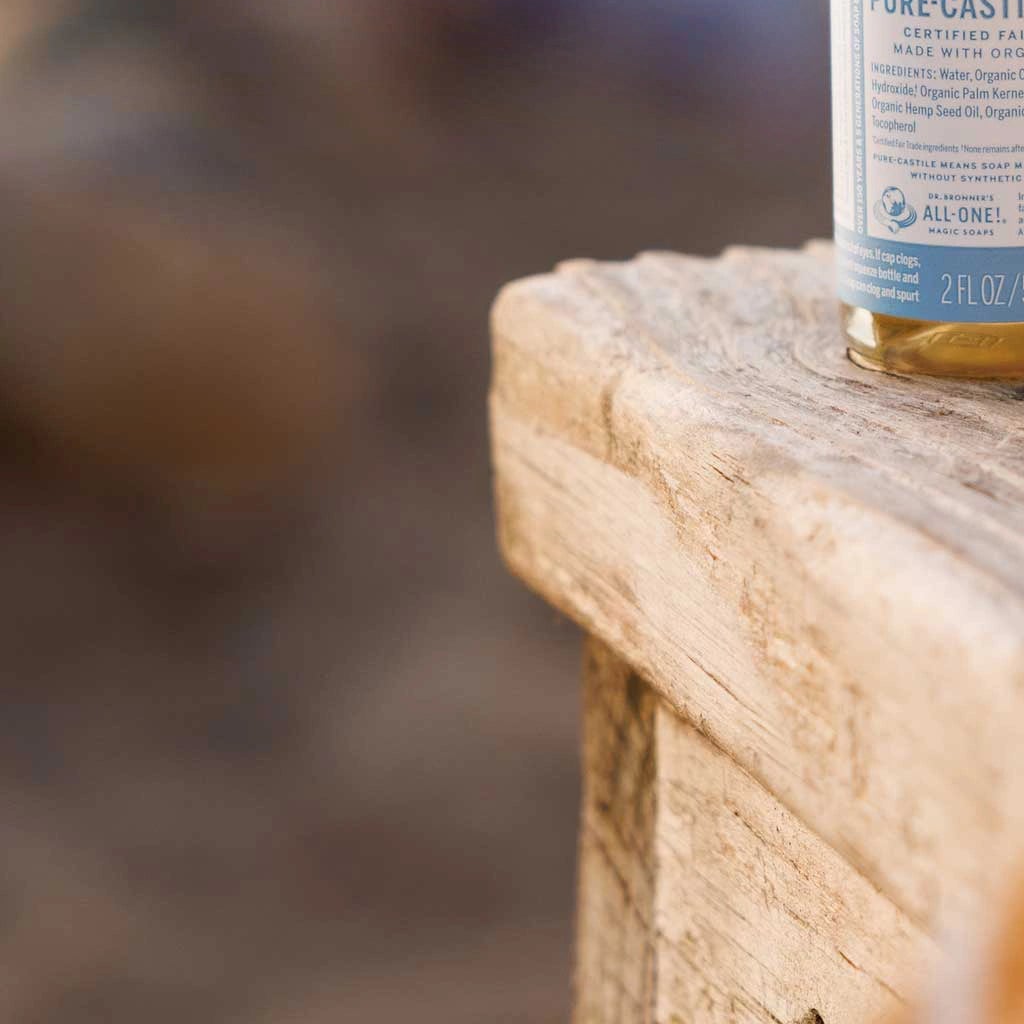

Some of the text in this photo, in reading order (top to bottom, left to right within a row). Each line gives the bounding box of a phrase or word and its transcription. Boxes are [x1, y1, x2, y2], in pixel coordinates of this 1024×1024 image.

[903, 27, 990, 41] CERTIFIED
[893, 43, 934, 57] MADE
[941, 47, 983, 59] WITH
[871, 62, 937, 80] INGREDIENTS:
[939, 69, 973, 82] Water,
[974, 68, 1016, 83] Organic
[920, 85, 960, 101] Organic
[962, 87, 989, 100] Palm
[871, 96, 903, 113] Organic
[905, 101, 934, 118] Hemp
[935, 105, 962, 118] Seed
[964, 105, 983, 119] Oil,
[871, 115, 916, 133] Tocopherol
[981, 143, 1012, 153] remains
[873, 153, 937, 168] PURE-CASTILE
[940, 161, 977, 170] MEANS
[981, 162, 1010, 170] SOAP
[910, 171, 956, 182] WITHOUT
[960, 174, 1022, 183] SYNTHETIC
[928, 192, 994, 202] DR. BRONNER'S
[923, 205, 1001, 224] ALL-ONE!
[928, 228, 994, 236] MAGIC SOAPS
[881, 251, 896, 266] cap
[896, 252, 921, 269] clogs,
[878, 266, 902, 282] bottle
[902, 271, 919, 284] and
[881, 286, 896, 299] and
[896, 290, 920, 303] spurt
[941, 273, 952, 304] 2
[957, 274, 978, 305] FL
